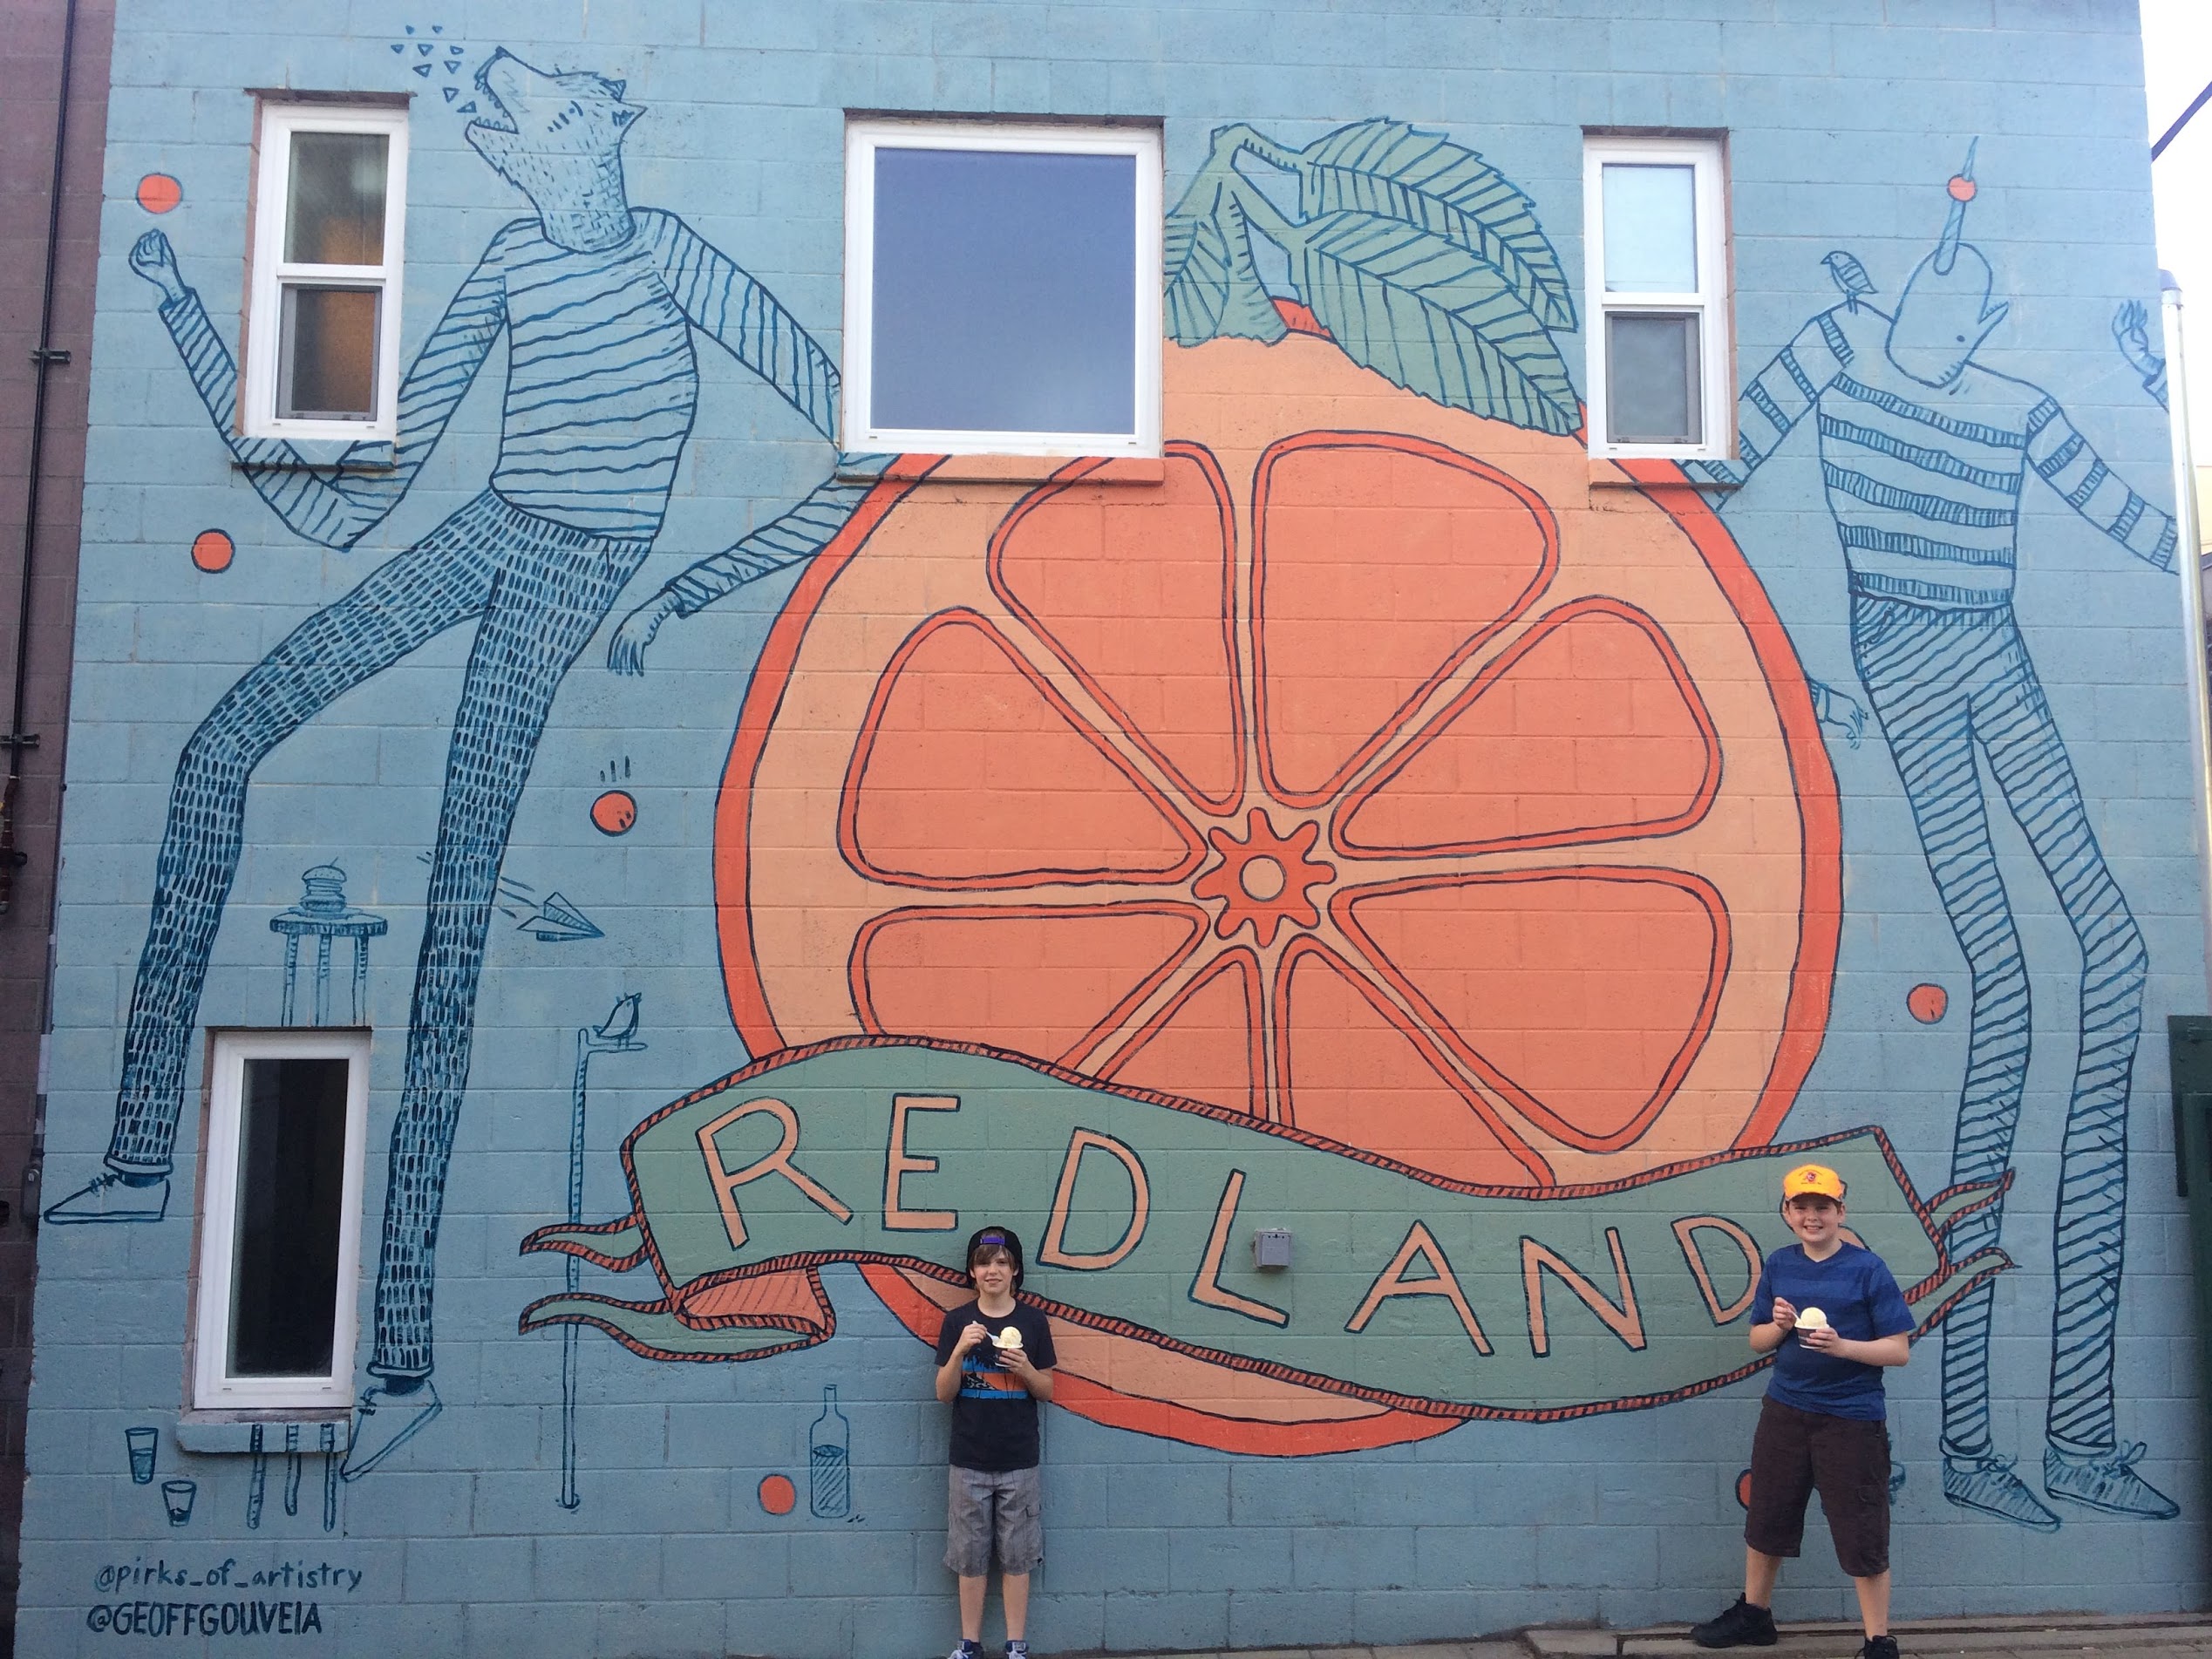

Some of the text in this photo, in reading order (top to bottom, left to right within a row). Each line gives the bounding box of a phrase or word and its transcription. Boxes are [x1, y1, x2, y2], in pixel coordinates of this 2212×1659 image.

[695, 1093, 1871, 1357] REDLAND
[94, 1556, 363, 1594] @pirks_of_artistry
[87, 1601, 323, 1637] @GEOFFGOUVEIA
